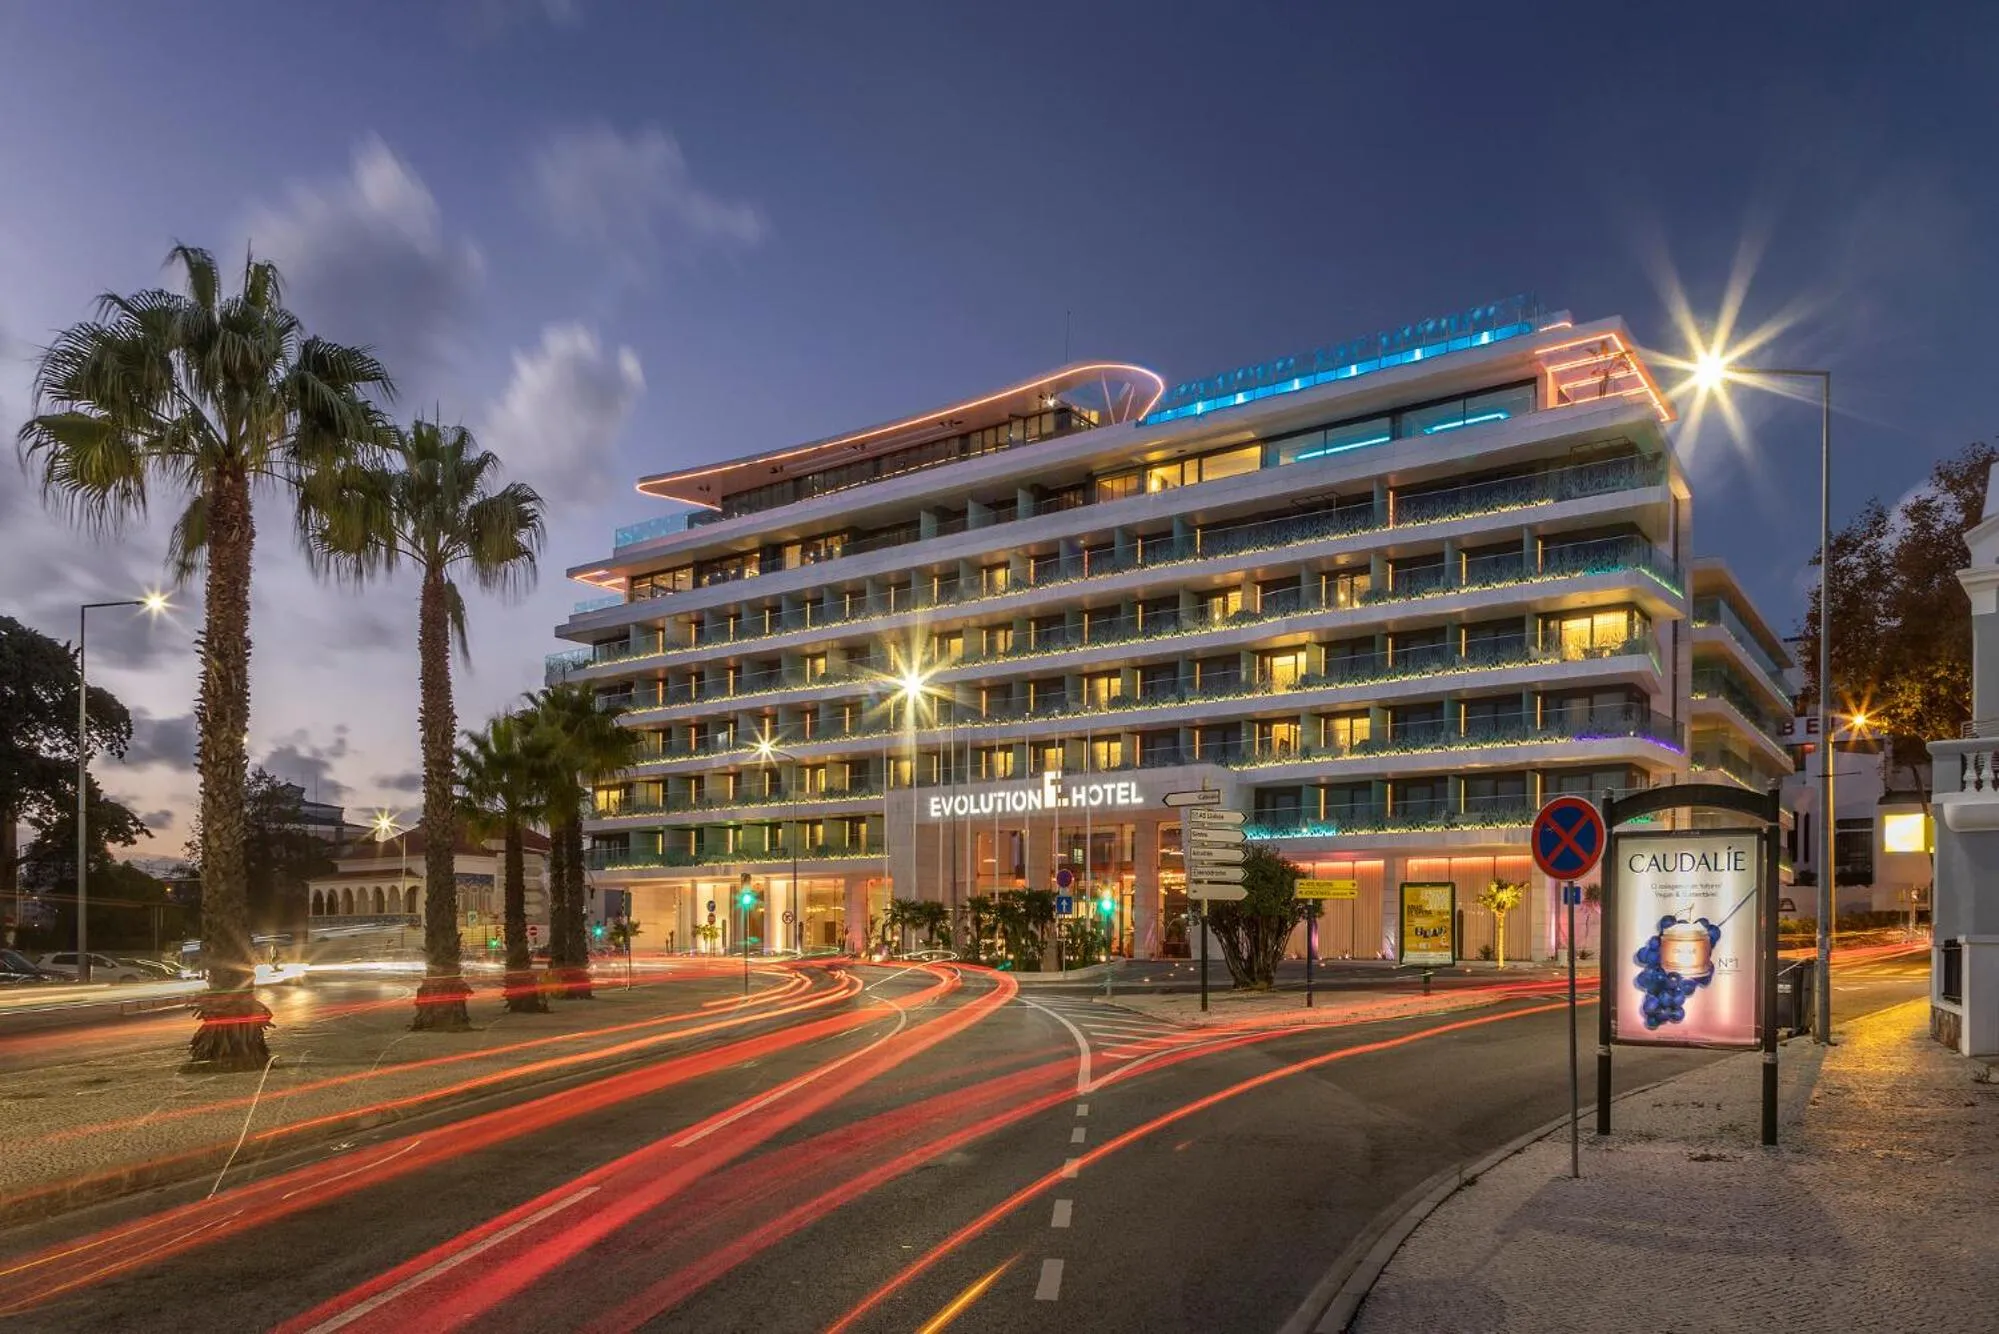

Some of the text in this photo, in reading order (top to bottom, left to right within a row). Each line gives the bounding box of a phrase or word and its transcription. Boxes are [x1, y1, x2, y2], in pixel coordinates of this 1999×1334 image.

[929, 788, 1042, 817] EVOLUTION
[1072, 781, 1144, 808] HOTEL
[1628, 845, 1746, 873] CAUDALÍE
